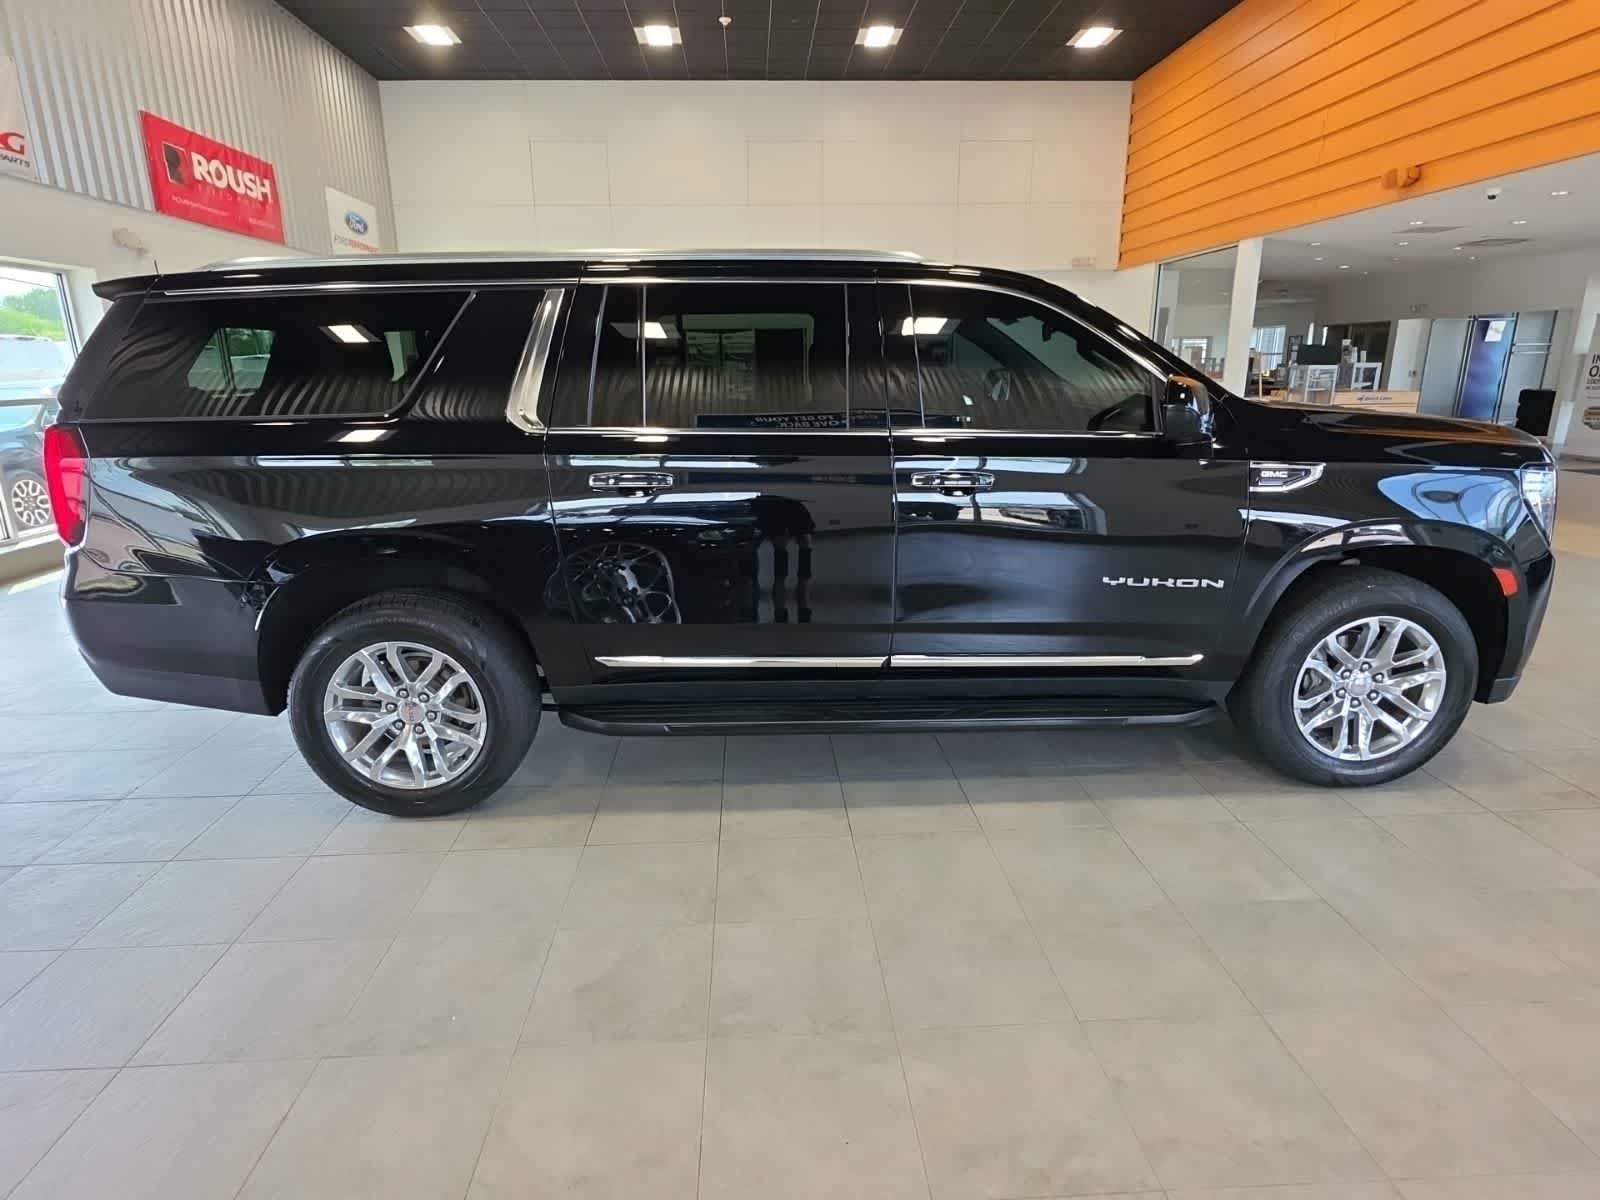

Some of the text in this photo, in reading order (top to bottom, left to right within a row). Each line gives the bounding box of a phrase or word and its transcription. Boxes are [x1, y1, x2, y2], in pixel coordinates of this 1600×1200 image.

[191, 152, 273, 204] ROUSH
[1261, 470, 1288, 478] GMC
[1102, 576, 1225, 589] YUKON
